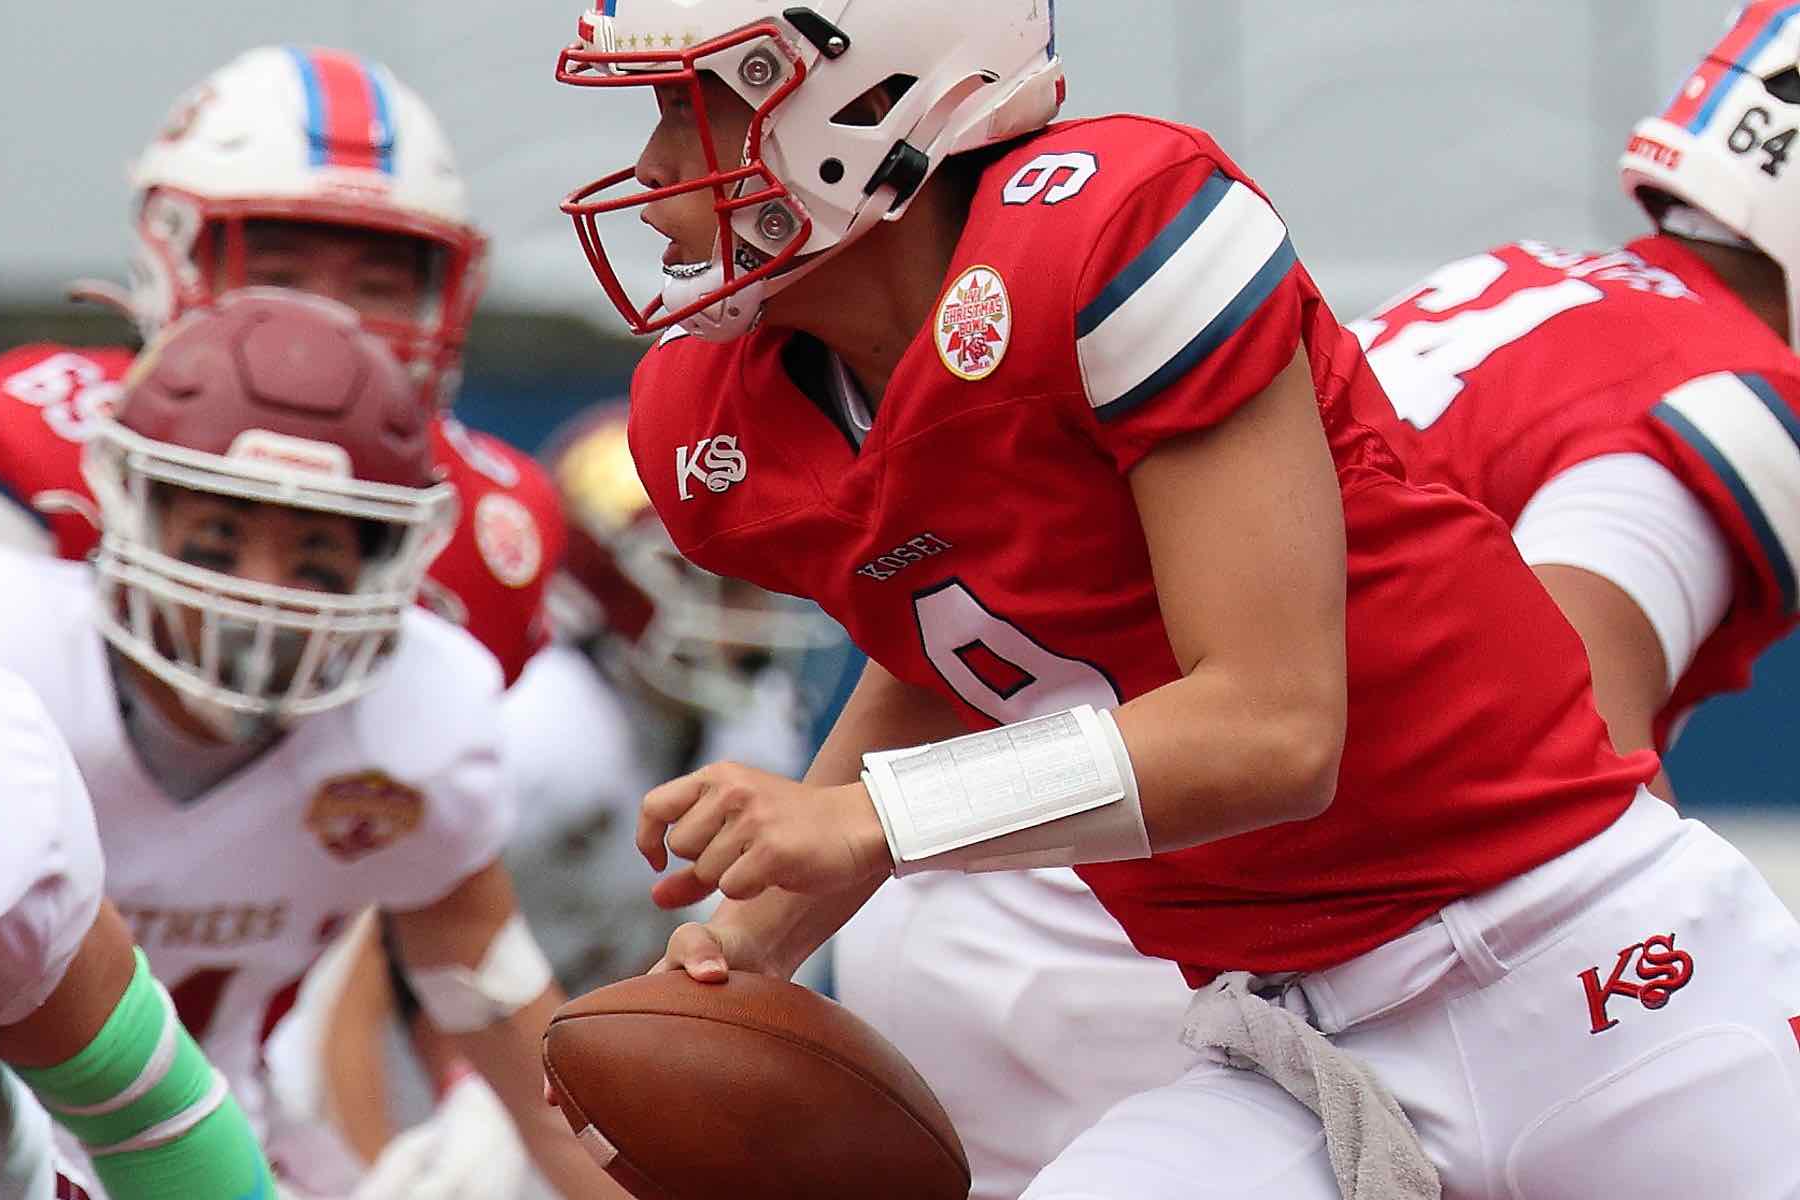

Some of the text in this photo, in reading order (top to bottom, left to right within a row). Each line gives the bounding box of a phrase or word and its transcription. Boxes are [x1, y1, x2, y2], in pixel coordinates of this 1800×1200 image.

[1728, 106, 1799, 177] 64
[1002, 151, 1099, 206] 9
[943, 298, 1001, 324] CHRISTMAS
[675, 433, 748, 502] KS
[856, 531, 954, 582] KOSEI
[1576, 932, 1694, 1035] KS
